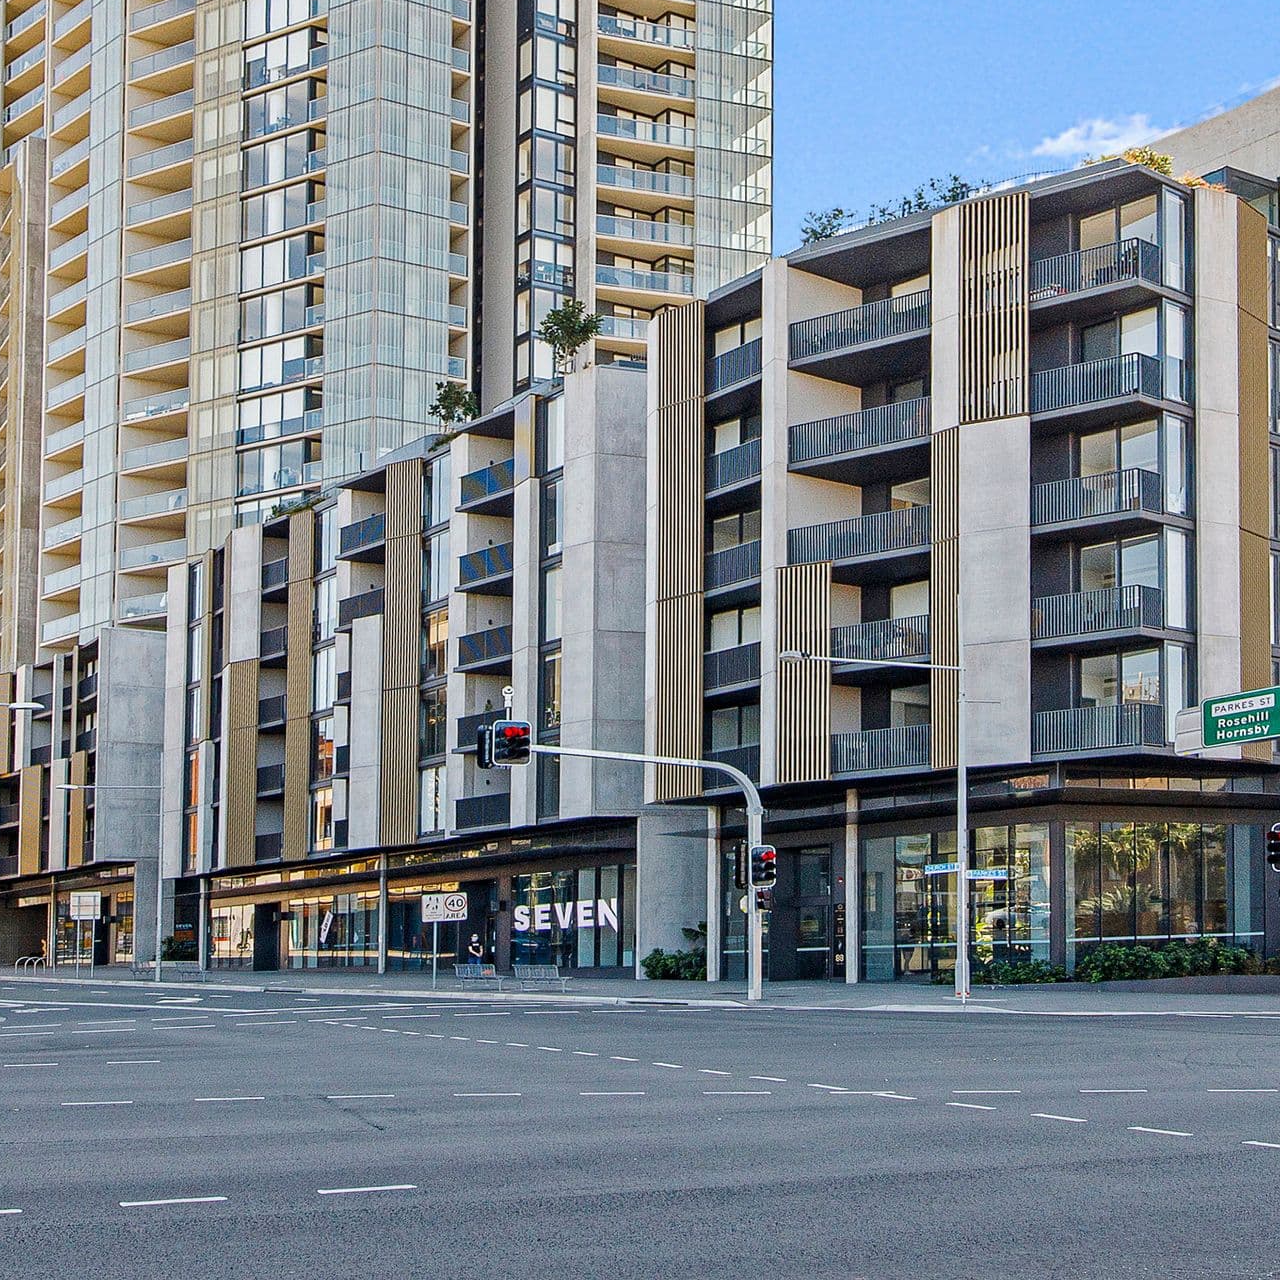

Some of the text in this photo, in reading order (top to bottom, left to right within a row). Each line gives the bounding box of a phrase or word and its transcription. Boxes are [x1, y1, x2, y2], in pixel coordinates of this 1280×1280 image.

[1214, 696, 1271, 714] PARKES ST
[1217, 711, 1269, 729] Rosehill
[1216, 724, 1270, 740] Hornsby
[448, 898, 464, 908] 40
[513, 897, 619, 933] SEVEN
